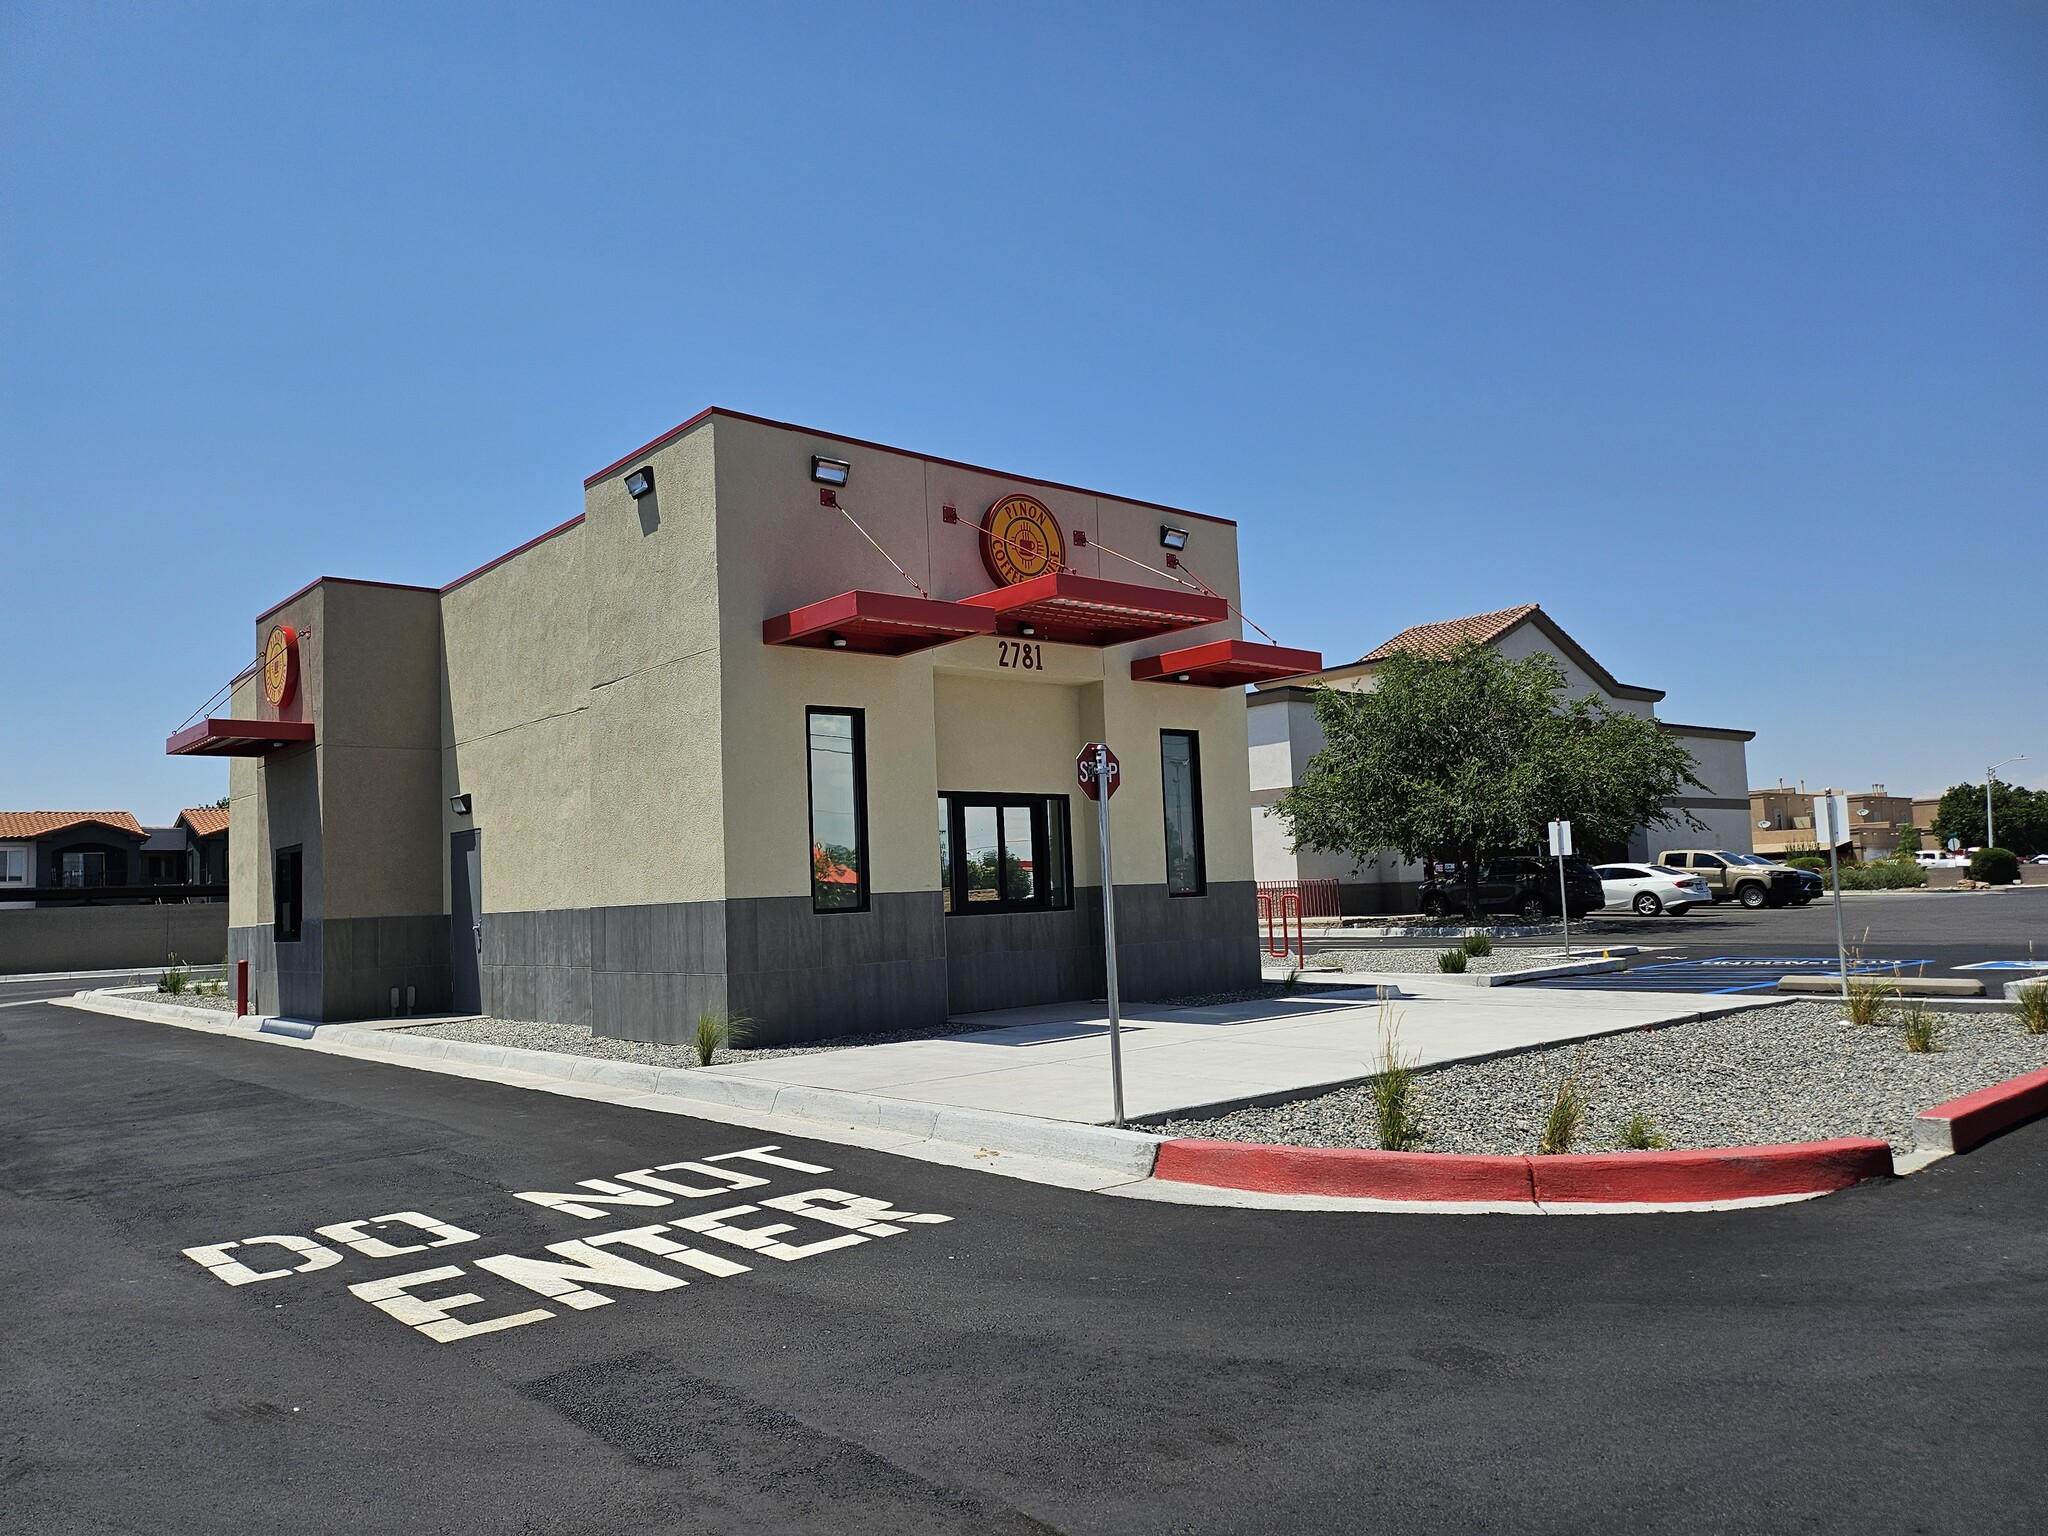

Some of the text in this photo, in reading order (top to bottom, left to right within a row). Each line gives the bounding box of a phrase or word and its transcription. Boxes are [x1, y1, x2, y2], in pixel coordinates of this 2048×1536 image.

[1004, 501, 1047, 526] PIÑON
[998, 640, 1043, 670] 2781
[1080, 761, 1118, 783] STP
[182, 1145, 833, 1286] DO NOT
[347, 1188, 956, 1343] ENTER
